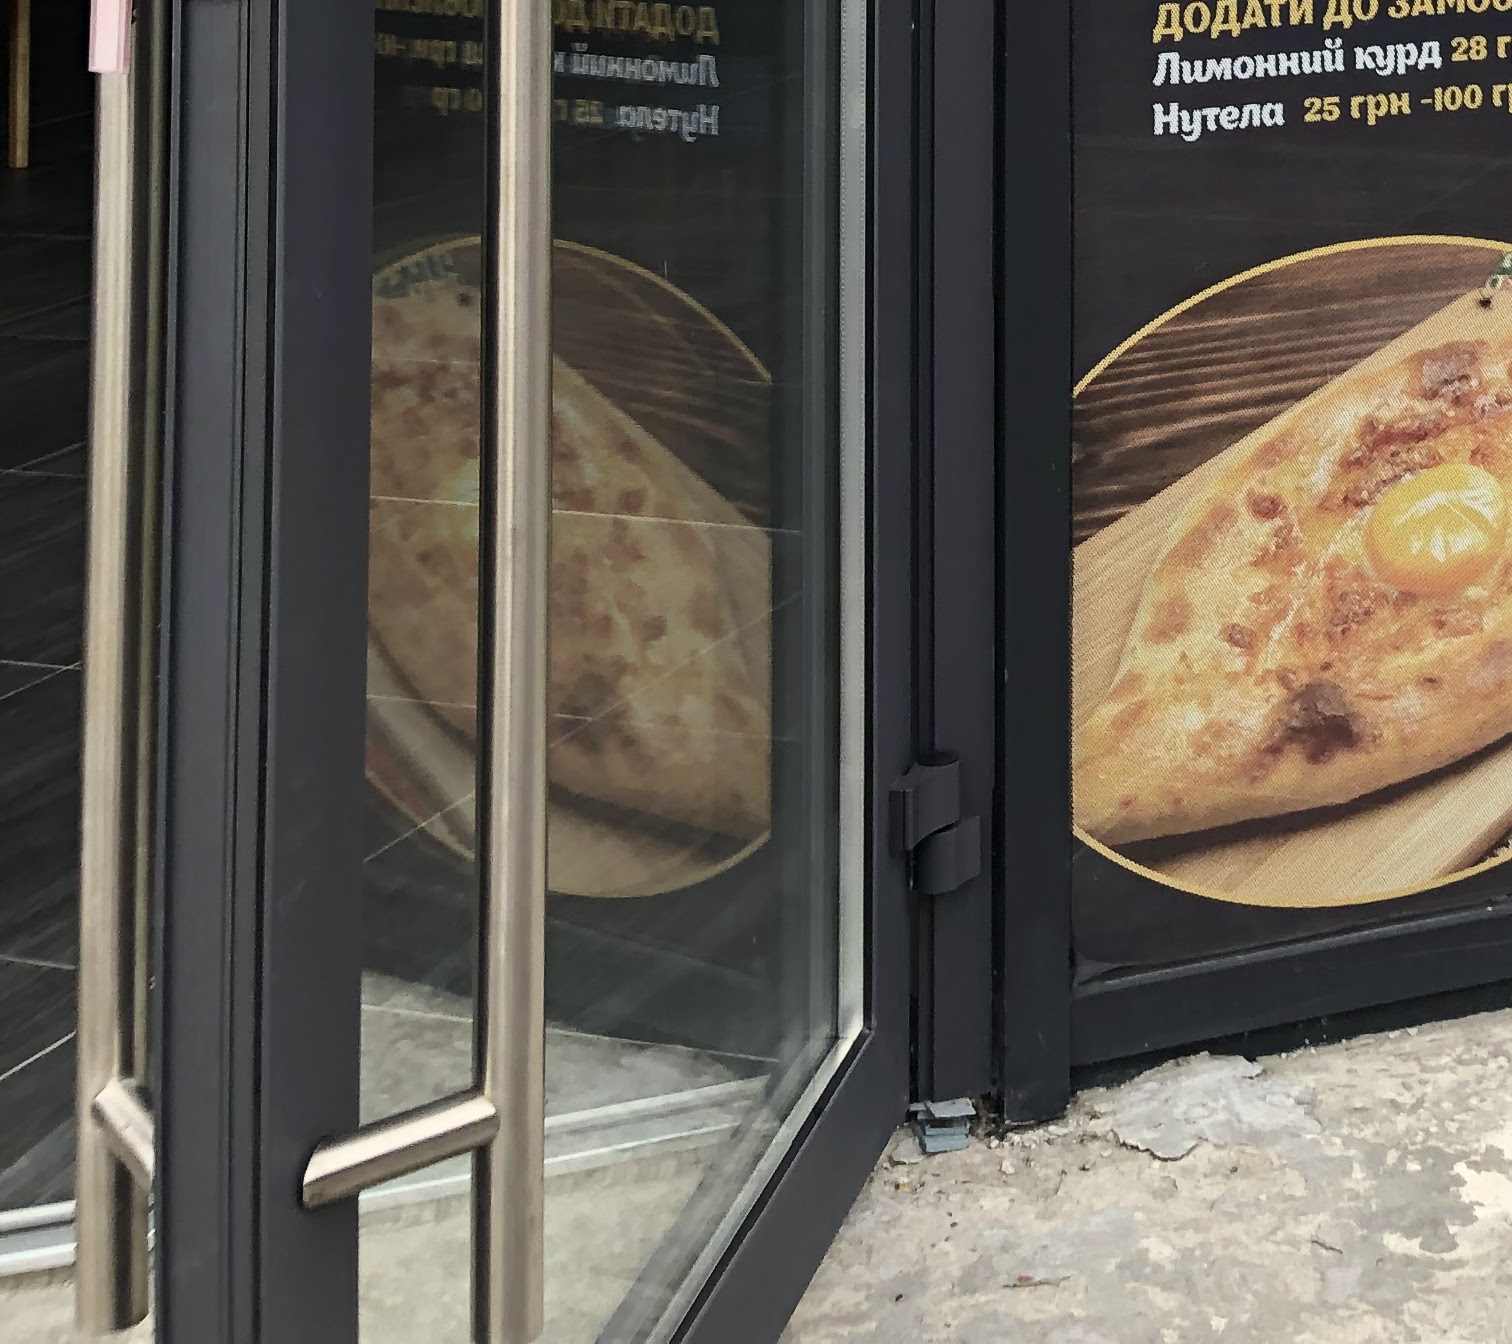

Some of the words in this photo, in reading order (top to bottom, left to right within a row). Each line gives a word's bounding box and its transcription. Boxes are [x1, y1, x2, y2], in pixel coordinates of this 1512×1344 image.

[1152, 37, 1345, 87] Лимонний
[1354, 39, 1443, 76] курд
[1451, 36, 1489, 64] 28
[1152, 102, 1285, 142] Нутела
[1303, 95, 1341, 123] 25
[1350, 90, 1411, 126] грн
[1419, 83, 1484, 112] -100
